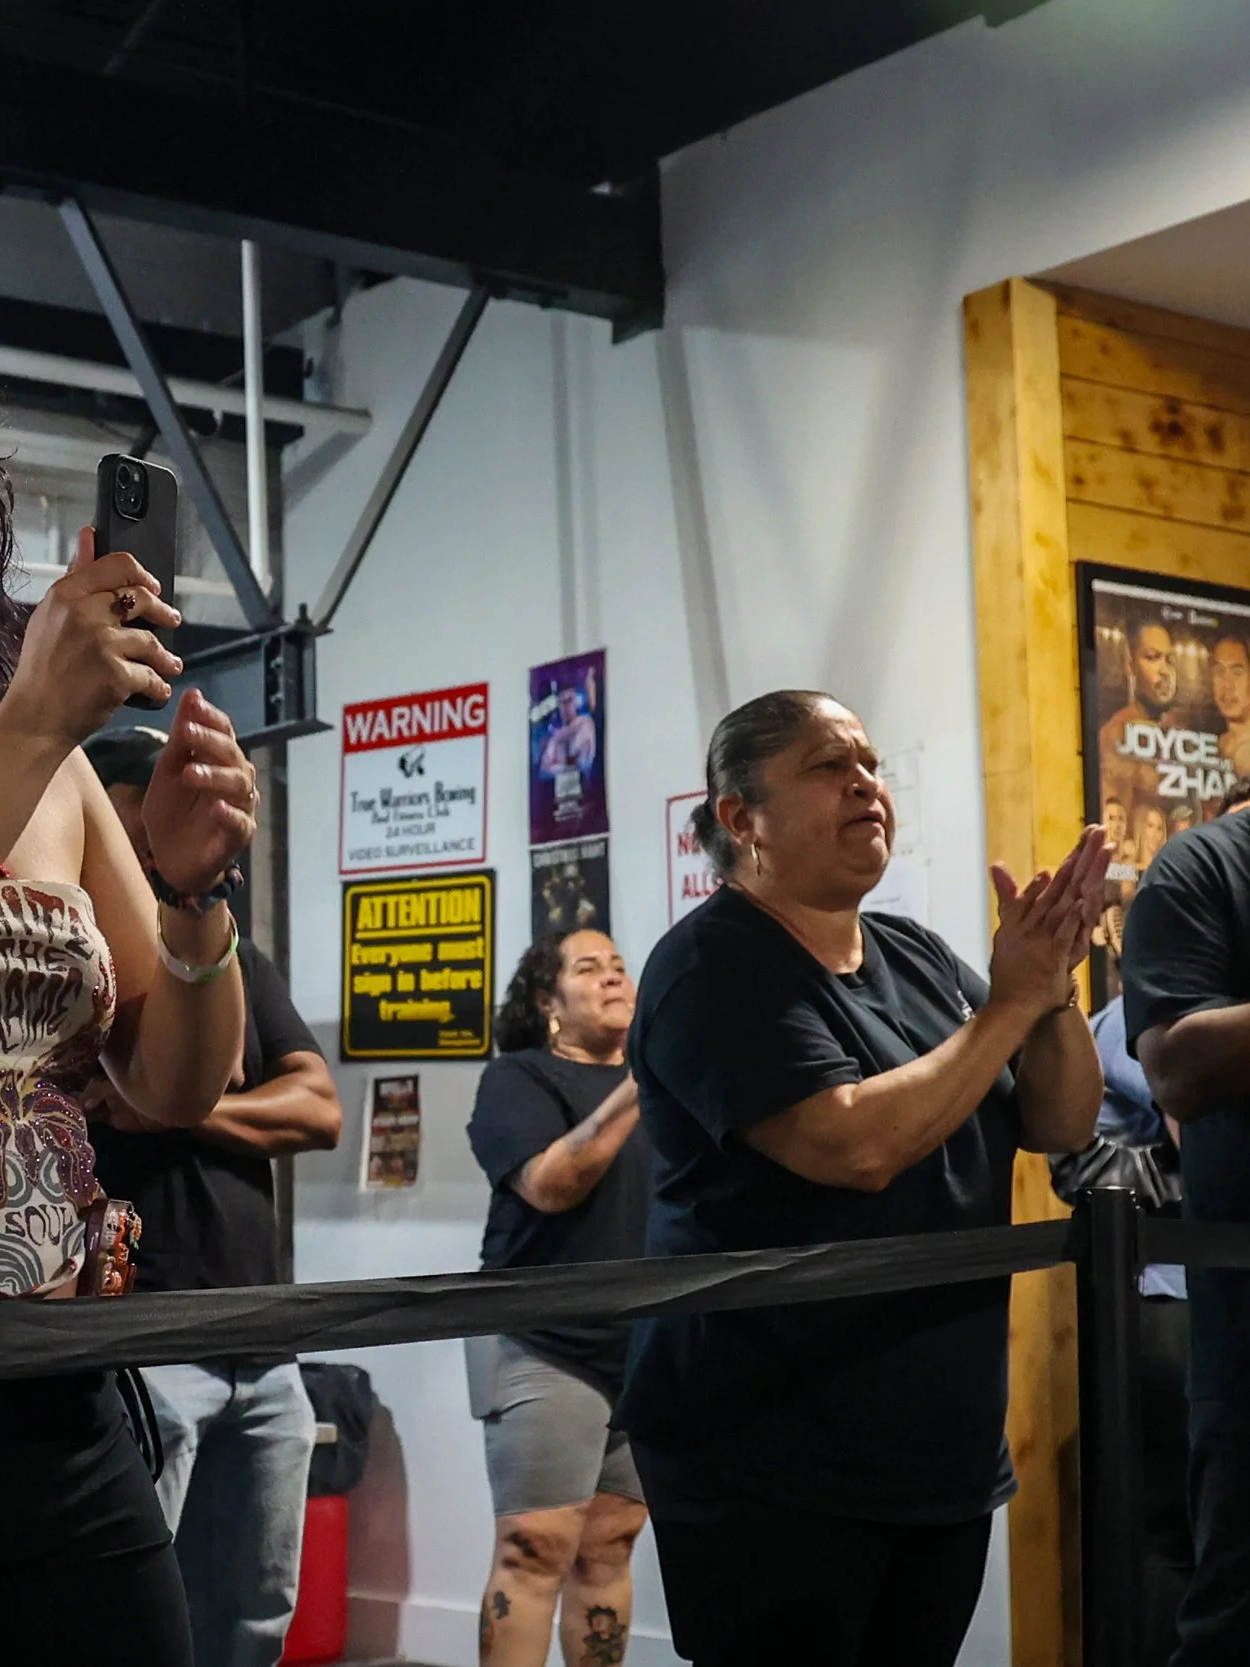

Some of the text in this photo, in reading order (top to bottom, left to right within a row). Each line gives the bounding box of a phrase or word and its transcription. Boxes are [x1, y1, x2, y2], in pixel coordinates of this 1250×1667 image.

[345, 693, 486, 746] WARNING
[1116, 722, 1220, 766] JOYCE
[350, 780, 476, 813] True Warriors Boxing
[401, 822, 436, 837] HOUR
[348, 836, 476, 862] VIDEO SURVEILLANCE
[356, 887, 482, 929] ATTENTION
[351, 935, 485, 967] Everyone must
[353, 967, 483, 997] sign in before
[4, 1204, 74, 1246] SOUL
